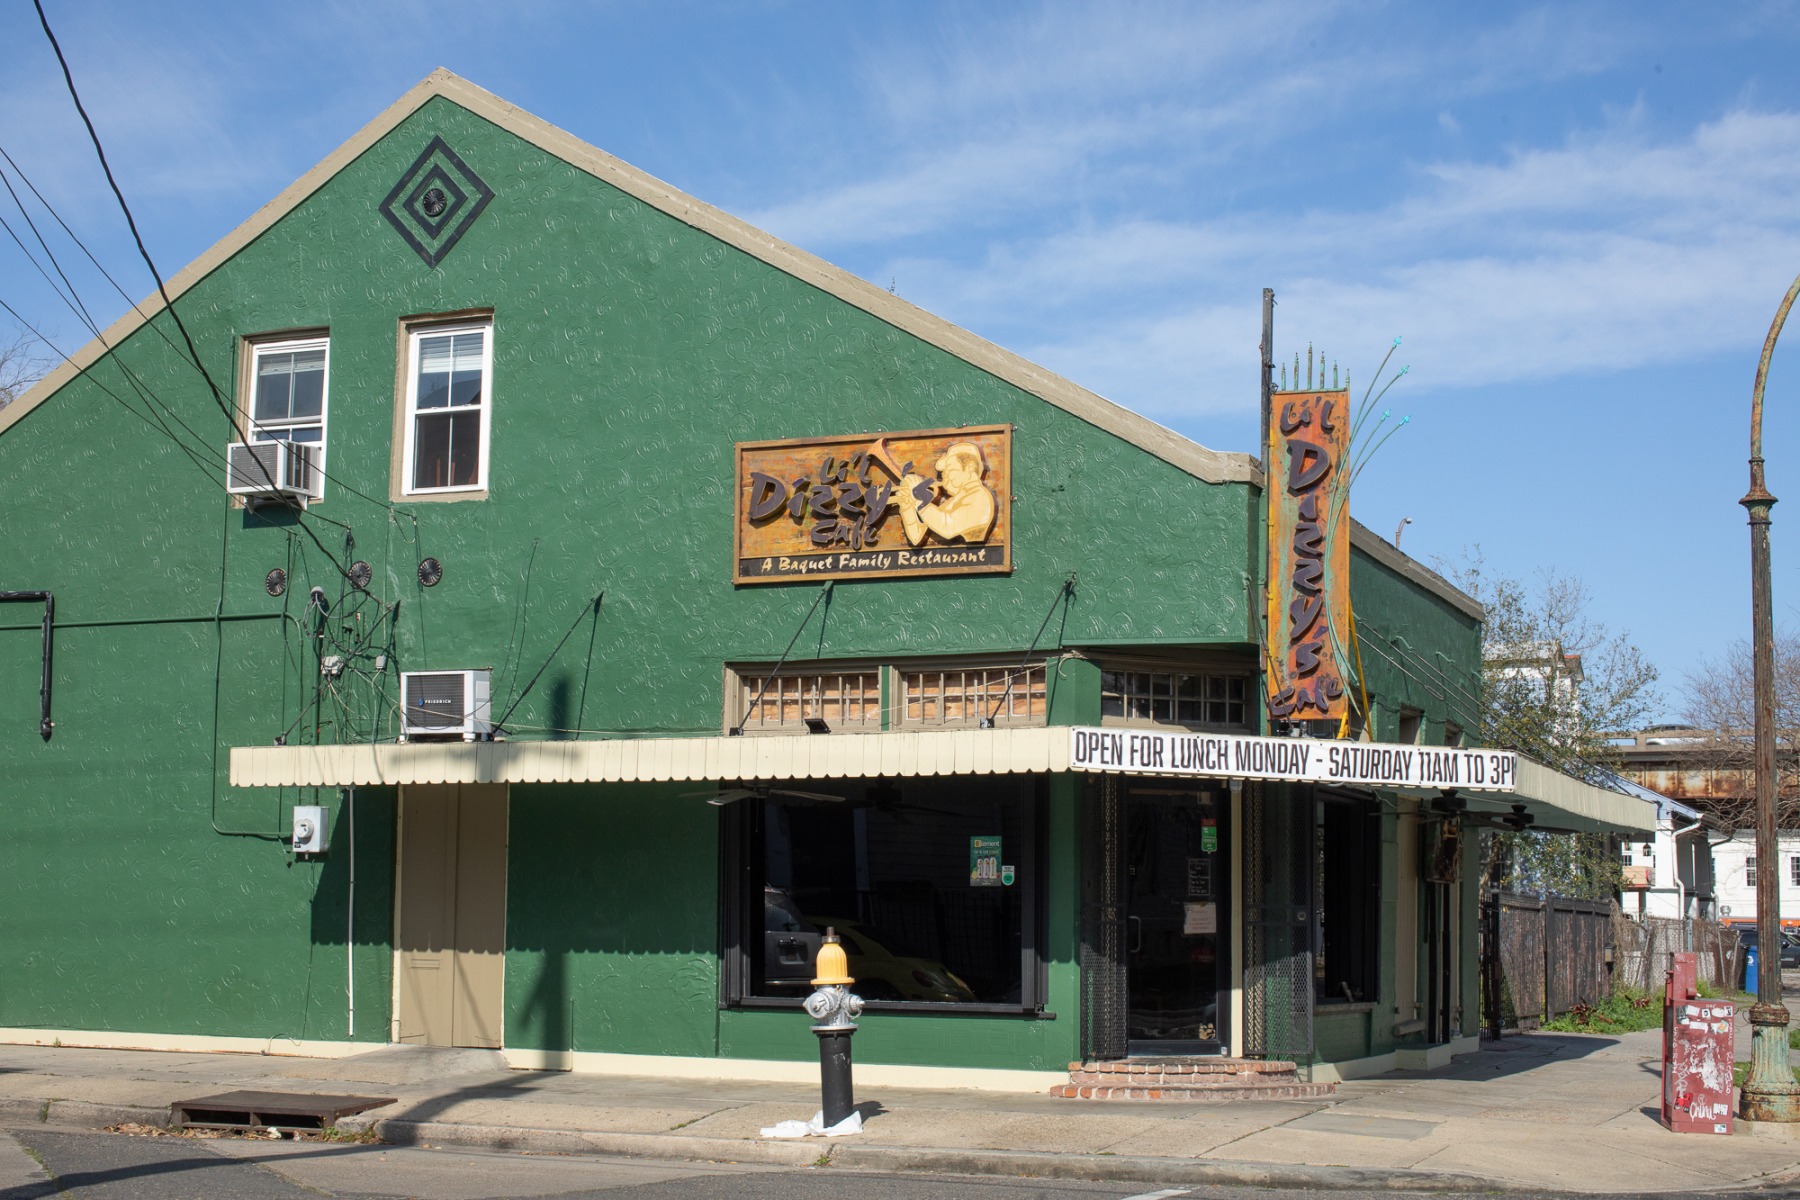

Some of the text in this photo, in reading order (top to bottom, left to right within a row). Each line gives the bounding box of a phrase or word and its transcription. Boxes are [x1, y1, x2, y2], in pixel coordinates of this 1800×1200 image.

[750, 460, 935, 526] Dizzy's
[811, 516, 879, 550] Cafe
[761, 549, 987, 574] A Baquet Family Restaurant
[1075, 731, 1123, 766] OPEN
[1130, 735, 1164, 767] FOR
[1171, 737, 1228, 770] LUNCH
[1235, 740, 1310, 774] MONDAY
[1329, 746, 1413, 781] SATURDAY
[1418, 751, 1459, 782] 11AM
[1464, 753, 1485, 784] TO
